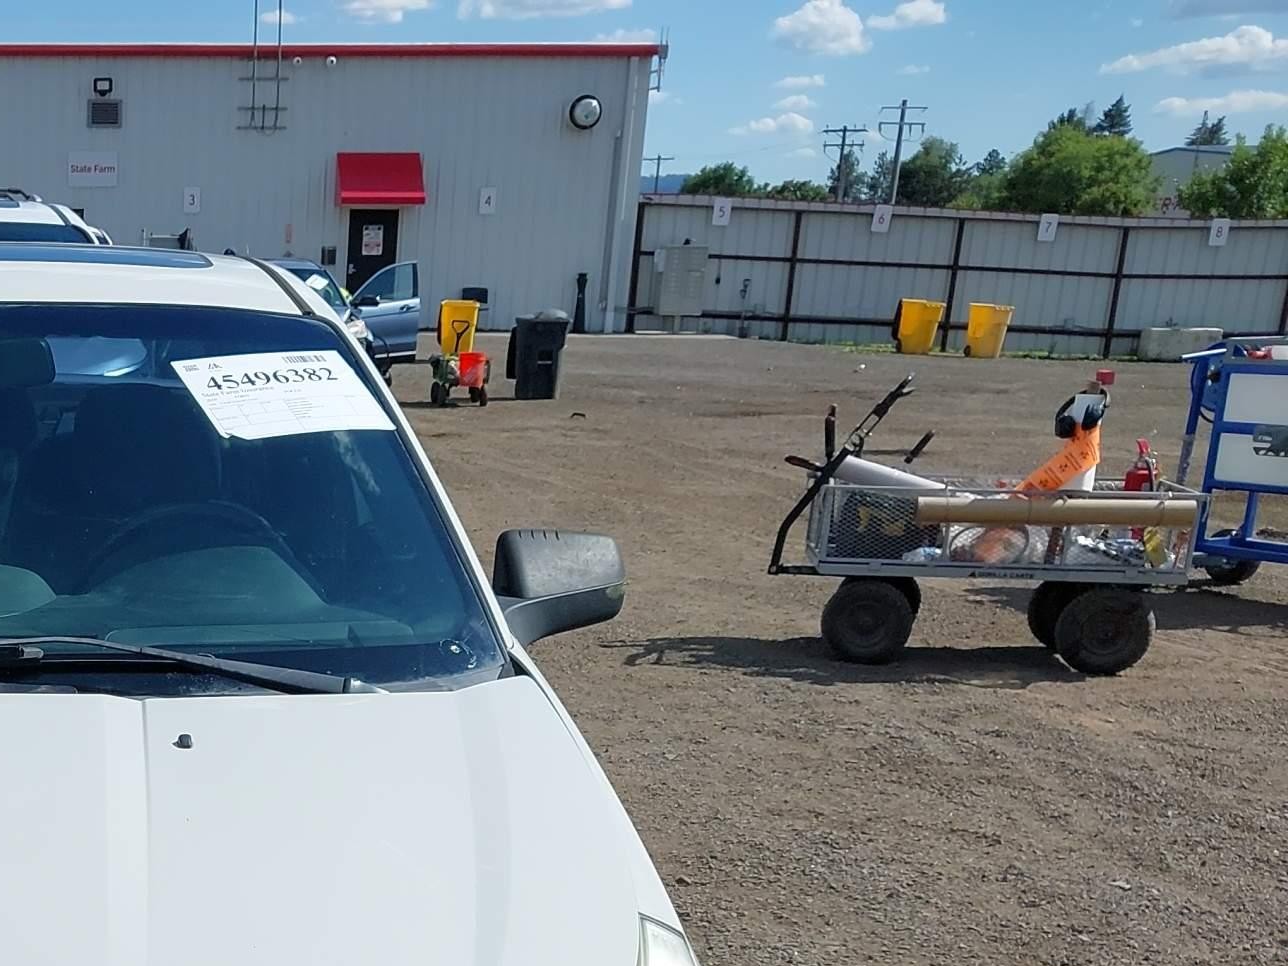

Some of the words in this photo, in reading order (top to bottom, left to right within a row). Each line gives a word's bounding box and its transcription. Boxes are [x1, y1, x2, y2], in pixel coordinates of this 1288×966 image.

[70, 164, 92, 174] State
[93, 164, 116, 174] Farm
[188, 194, 196, 206] 3
[484, 195, 492, 207] 4
[719, 206, 726, 218] 5
[878, 215, 885, 225] 6
[1045, 221, 1053, 233] 7
[1215, 226, 1223, 238] 8
[207, 367, 338, 390] 45496382
